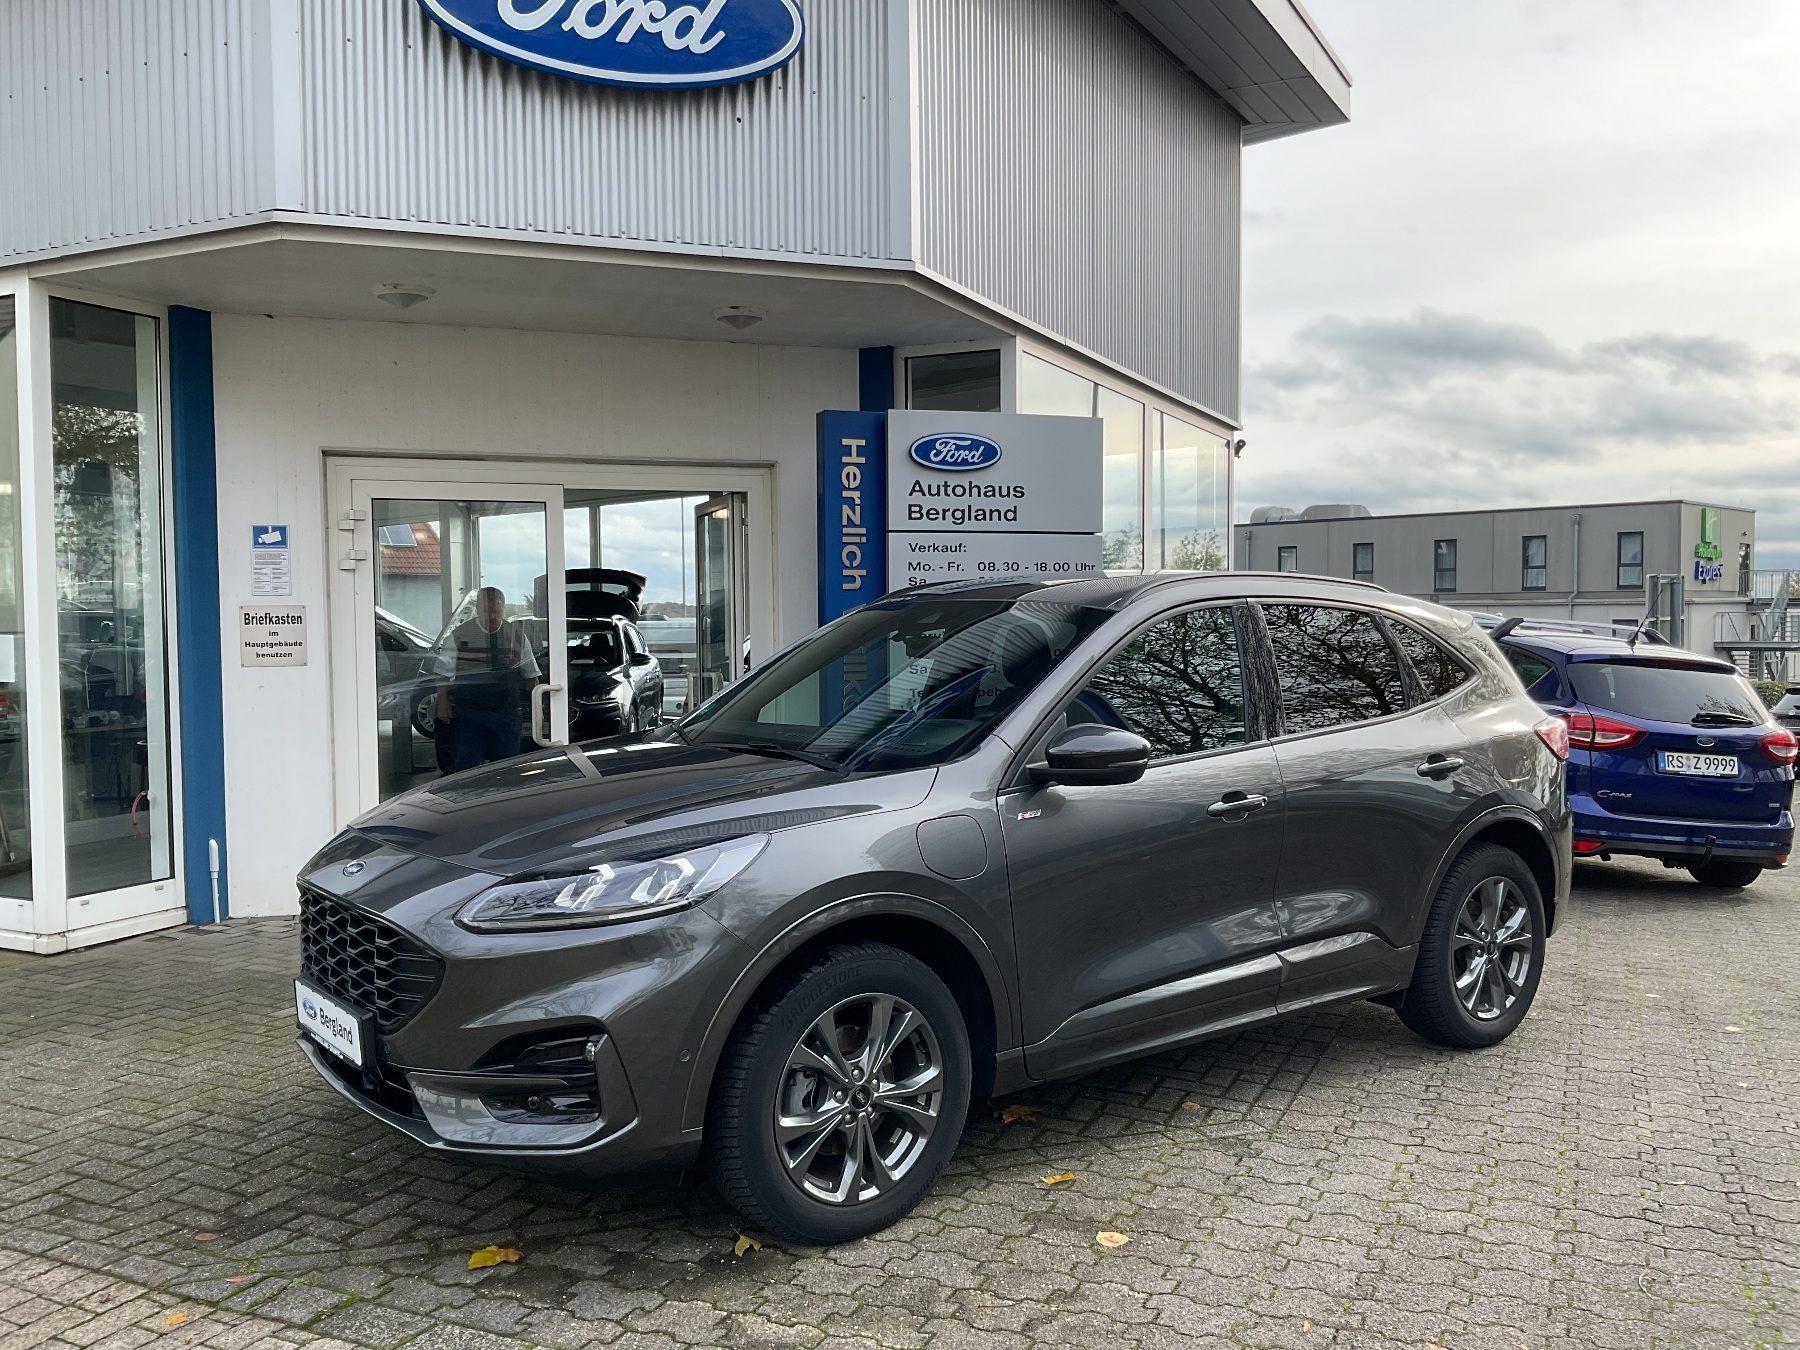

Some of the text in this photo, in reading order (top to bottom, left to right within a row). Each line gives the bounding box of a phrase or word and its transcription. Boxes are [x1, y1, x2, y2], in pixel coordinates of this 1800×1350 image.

[930, 438, 985, 463] Ford
[908, 479, 1025, 498] Autohaus
[841, 438, 867, 590] Herzlich
[908, 503, 1018, 525] Bergland
[908, 542, 967, 553] Verkauf:
[908, 561, 935, 572] Mo.
[948, 561, 965, 572] Fr.
[977, 561, 1020, 572] 08.30
[1034, 561, 1070, 572] 18.00
[1075, 562, 1096, 572] Uhr
[243, 612, 303, 626] Briefkasten
[244, 641, 303, 649] Hauptgebäude
[256, 651, 293, 659] benutzen
[1666, 754, 1736, 773] RS Z 9999
[320, 1007, 353, 1045] Bergland
